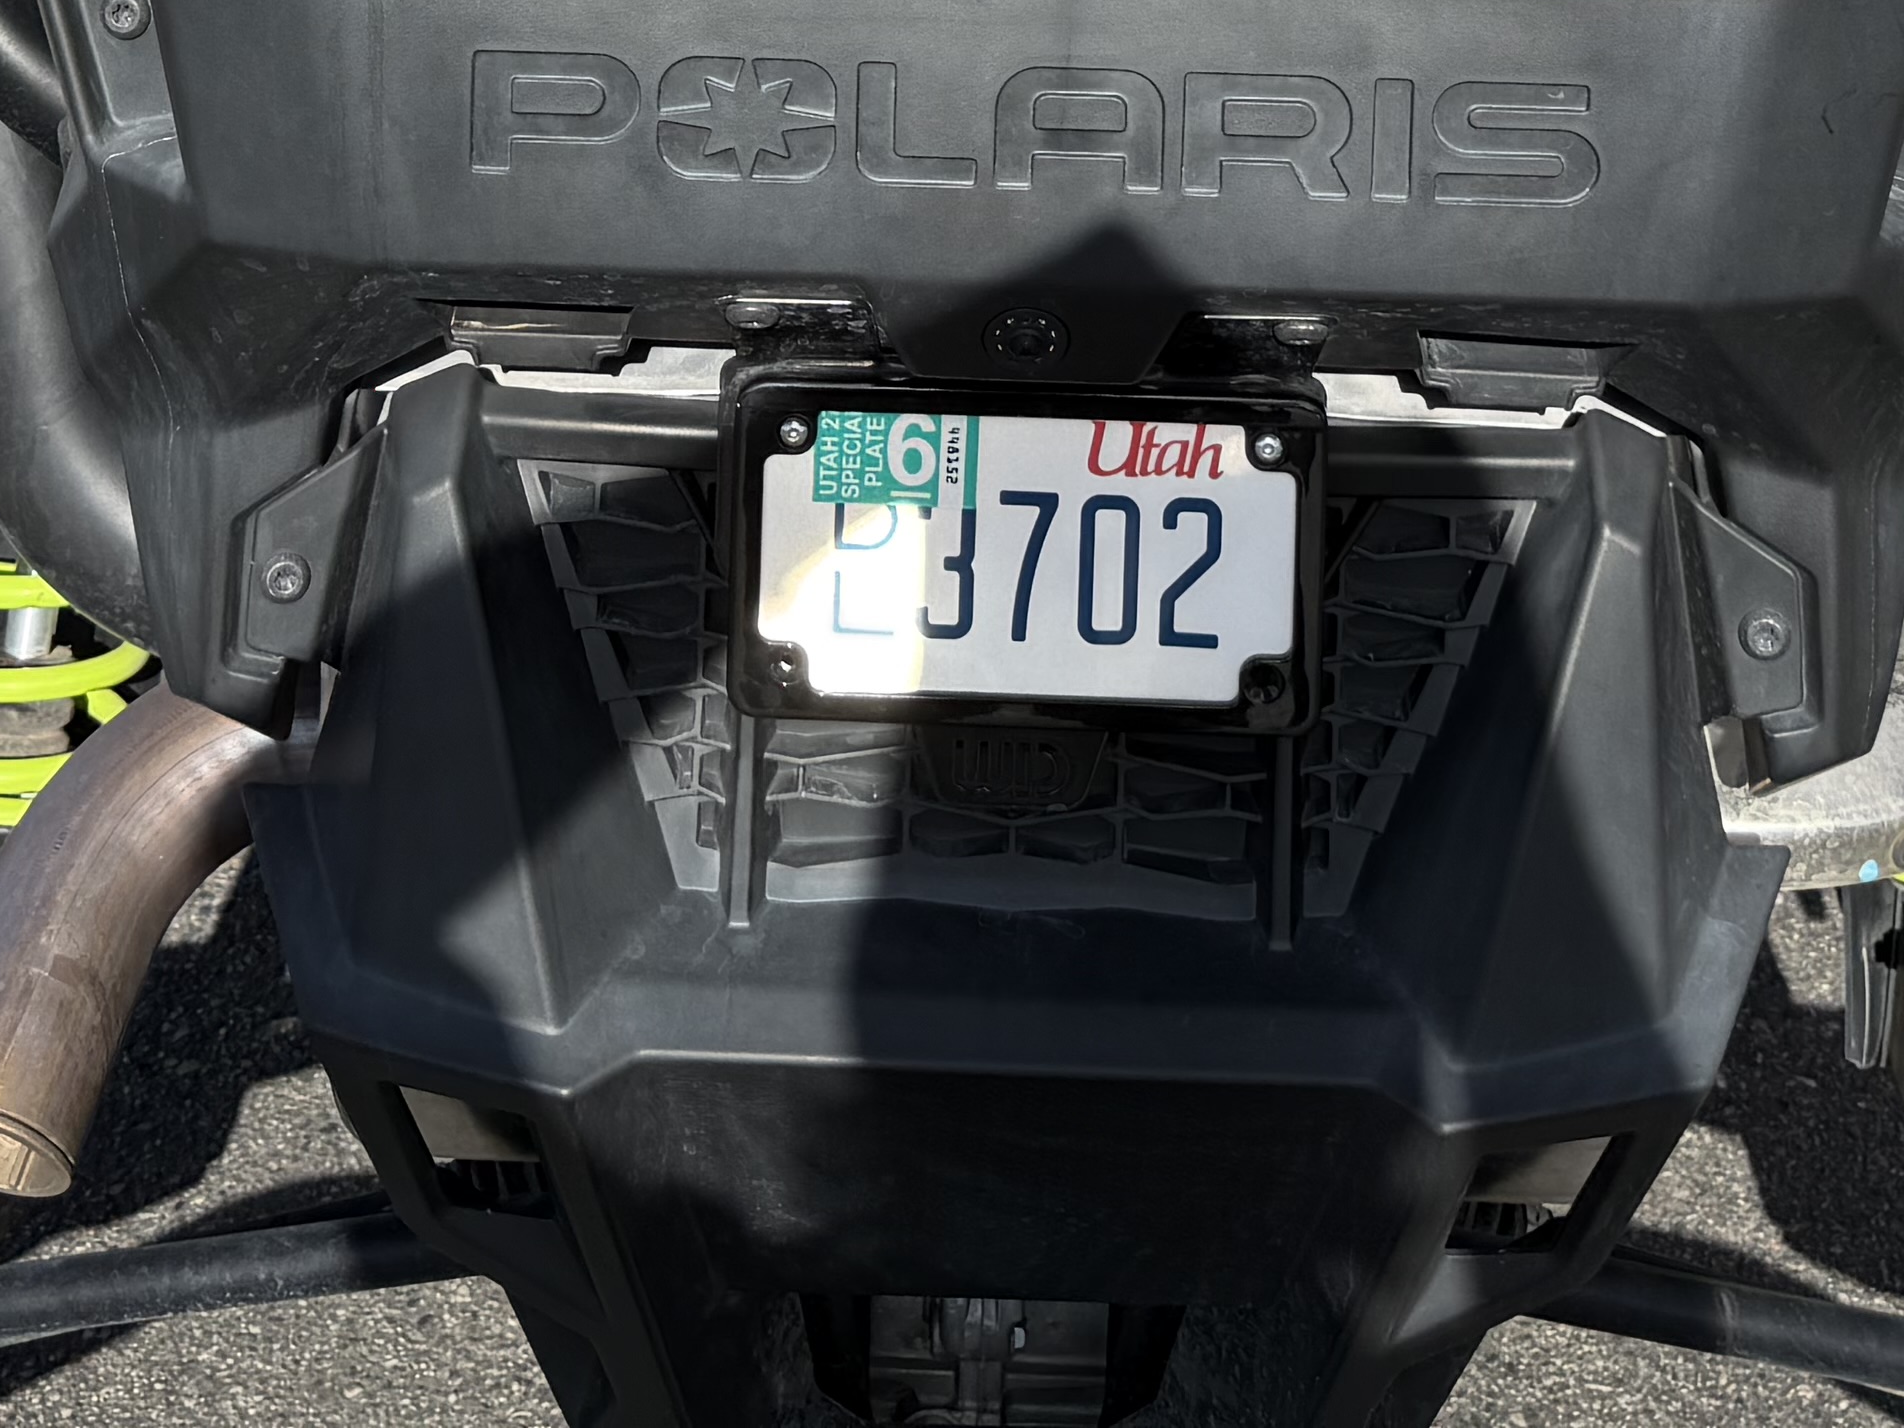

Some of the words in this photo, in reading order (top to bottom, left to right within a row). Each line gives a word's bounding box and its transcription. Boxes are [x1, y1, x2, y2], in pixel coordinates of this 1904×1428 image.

[470, 49, 1603, 208] POLARIS
[821, 410, 839, 429] 2
[864, 416, 885, 486] PLATE
[887, 414, 937, 487] 6
[1087, 420, 1224, 480] Utah
[819, 436, 839, 494] UTAH
